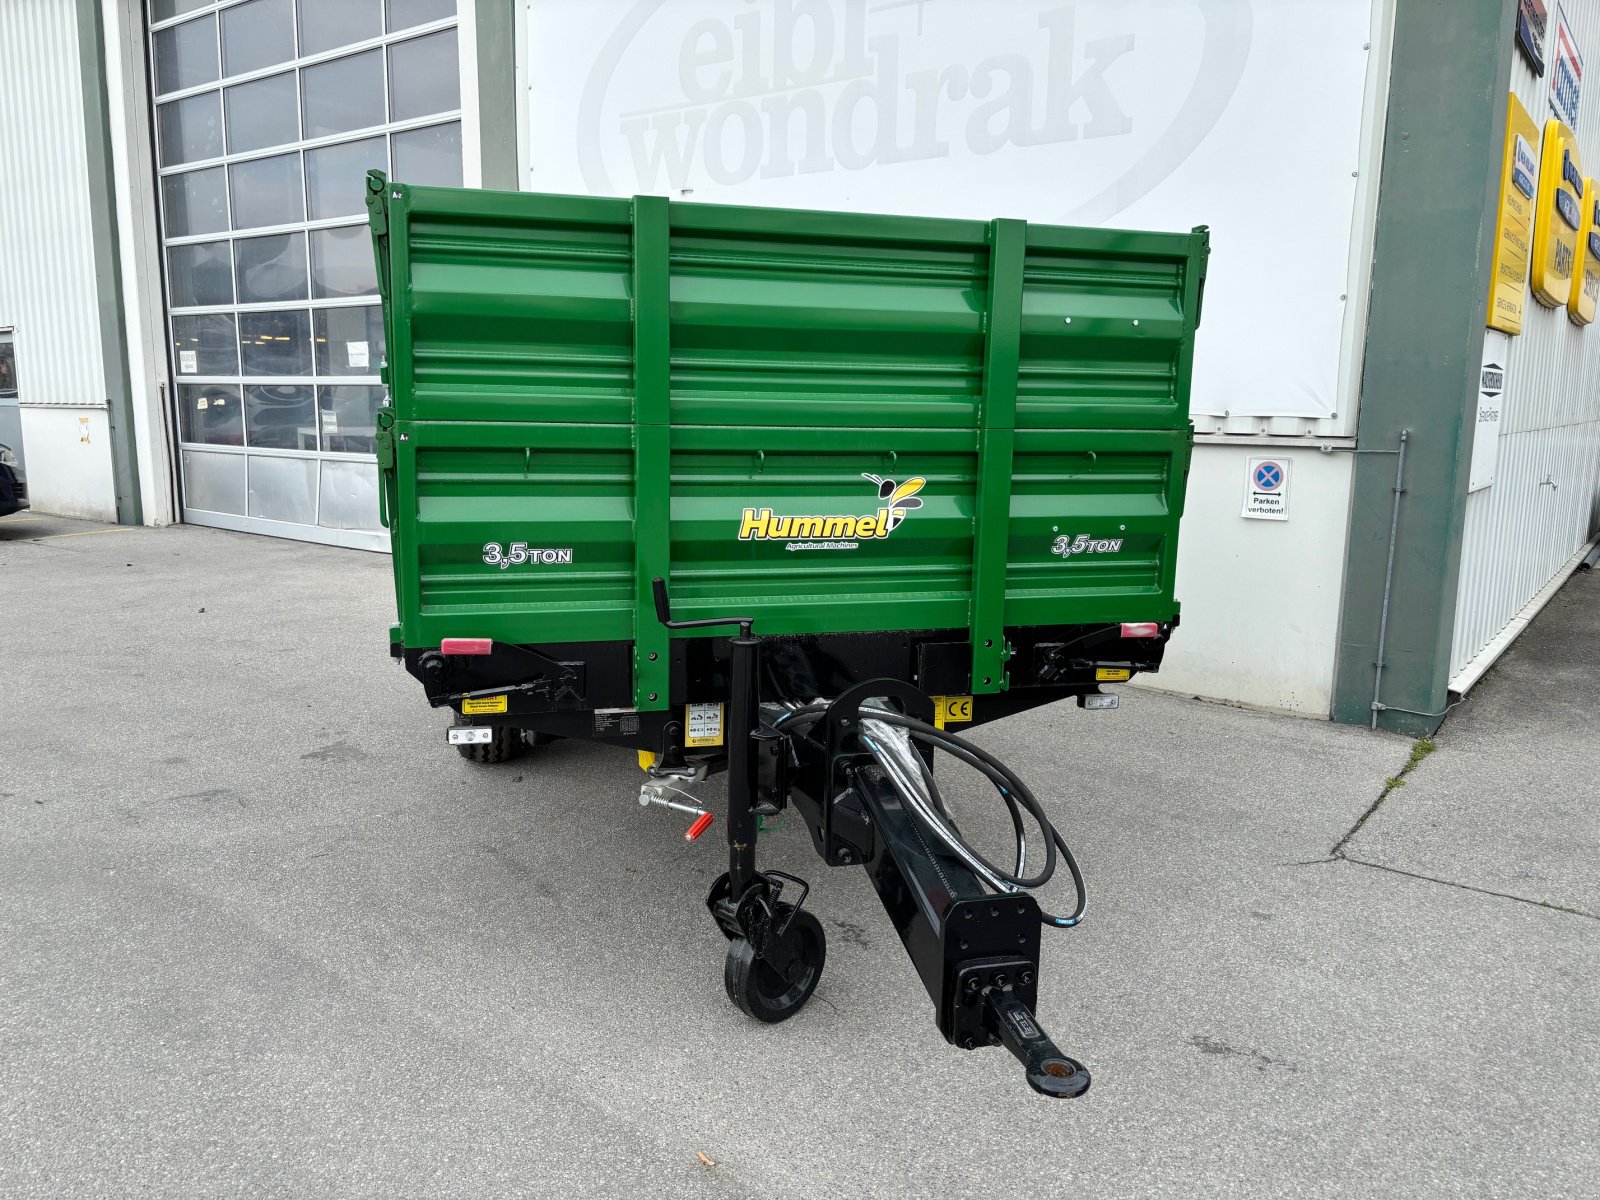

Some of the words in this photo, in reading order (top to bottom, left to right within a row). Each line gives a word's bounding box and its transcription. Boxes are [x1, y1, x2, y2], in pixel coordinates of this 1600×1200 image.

[679, 0, 874, 101] eibl
[619, 4, 1136, 192] wondrak
[1253, 497, 1280, 505] Parken
[738, 508, 890, 541] Hummel
[786, 542, 826, 551] Agricultural
[826, 541, 859, 550] Machines
